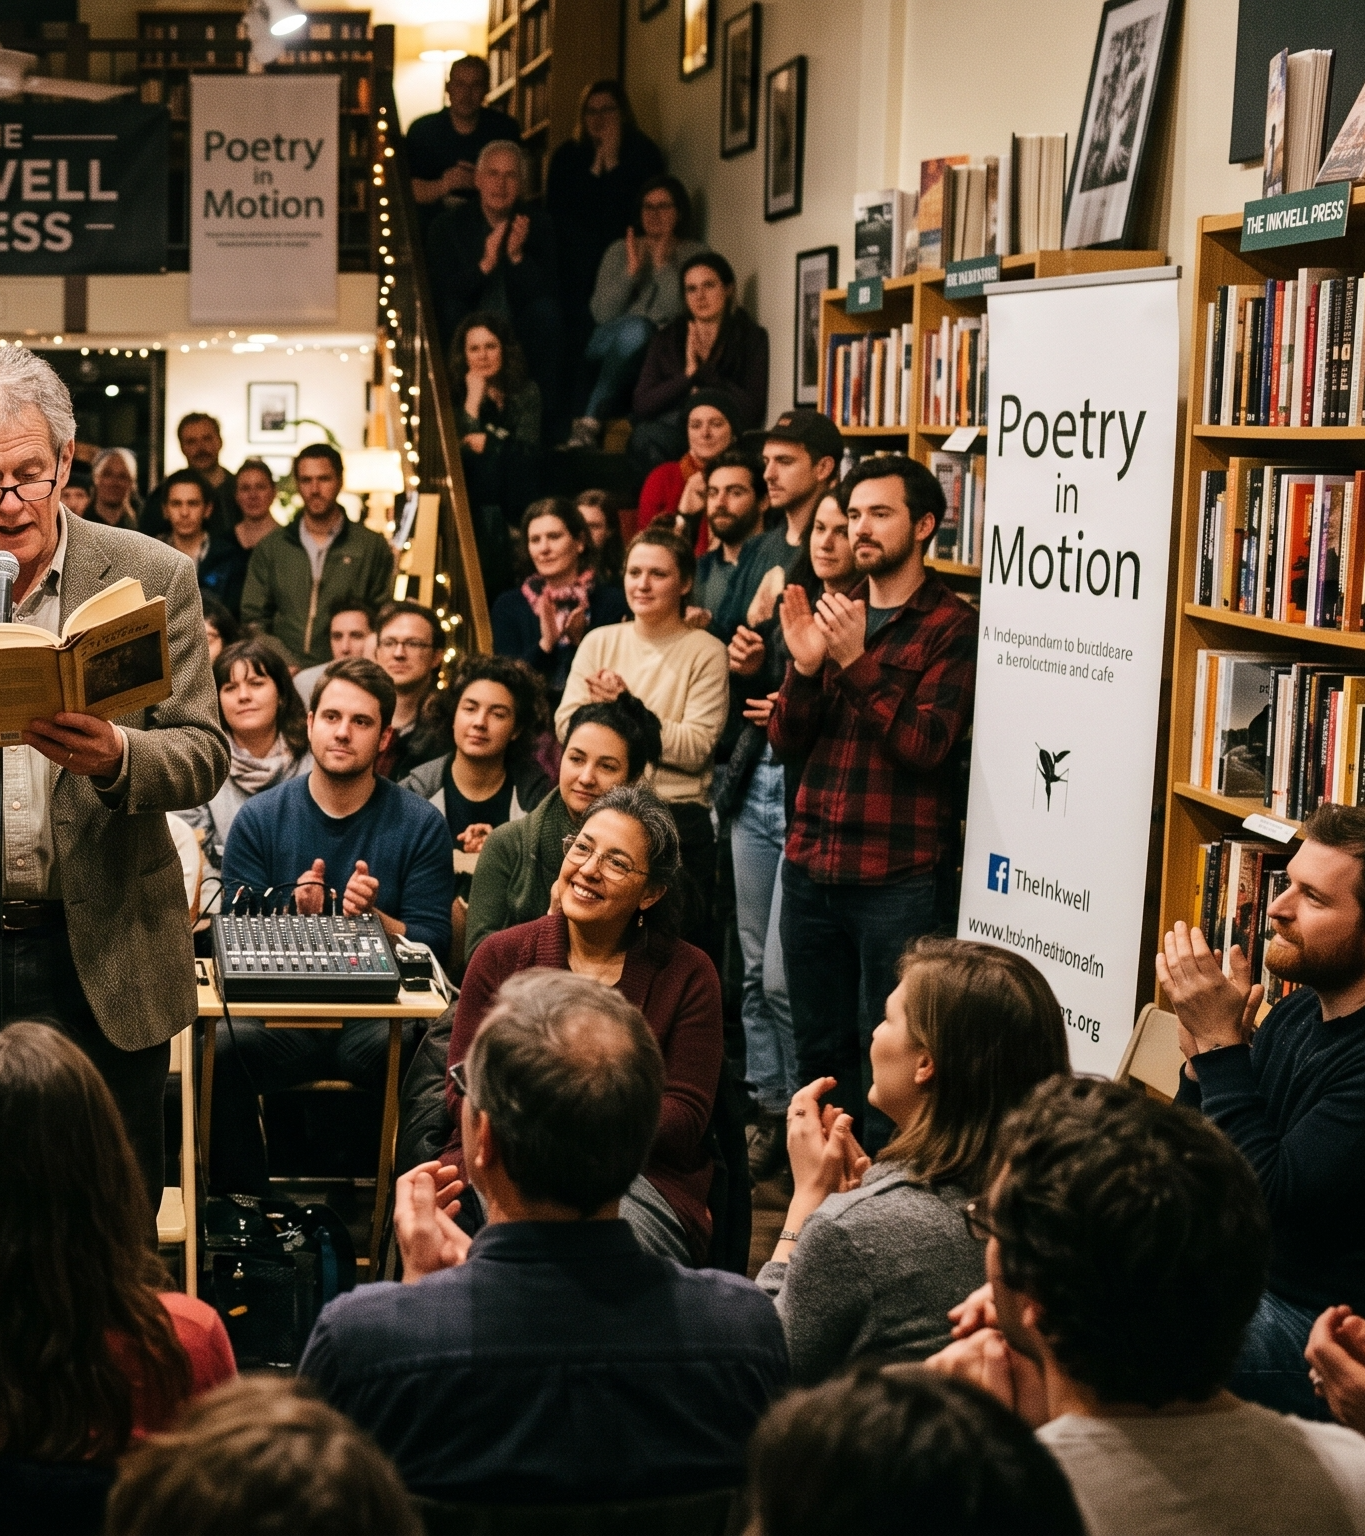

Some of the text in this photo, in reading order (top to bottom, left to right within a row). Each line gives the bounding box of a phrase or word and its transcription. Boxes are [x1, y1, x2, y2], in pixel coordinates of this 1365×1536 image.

[203, 130, 325, 170] Poetry
[253, 166, 273, 186] in
[202, 189, 325, 220] Motion
[1246, 214, 1265, 235] THE
[1310, 199, 1345, 224] PRESS
[998, 394, 1147, 482] Poetry
[1055, 472, 1078, 514] in
[989, 524, 1141, 600] Motion
[983, 626, 990, 640] A
[1064, 637, 1075, 653] to
[997, 653, 1003, 665] a
[1069, 663, 1089, 679] and
[1091, 666, 1114, 683] cafe
[1014, 868, 1091, 912] TheInkwell
